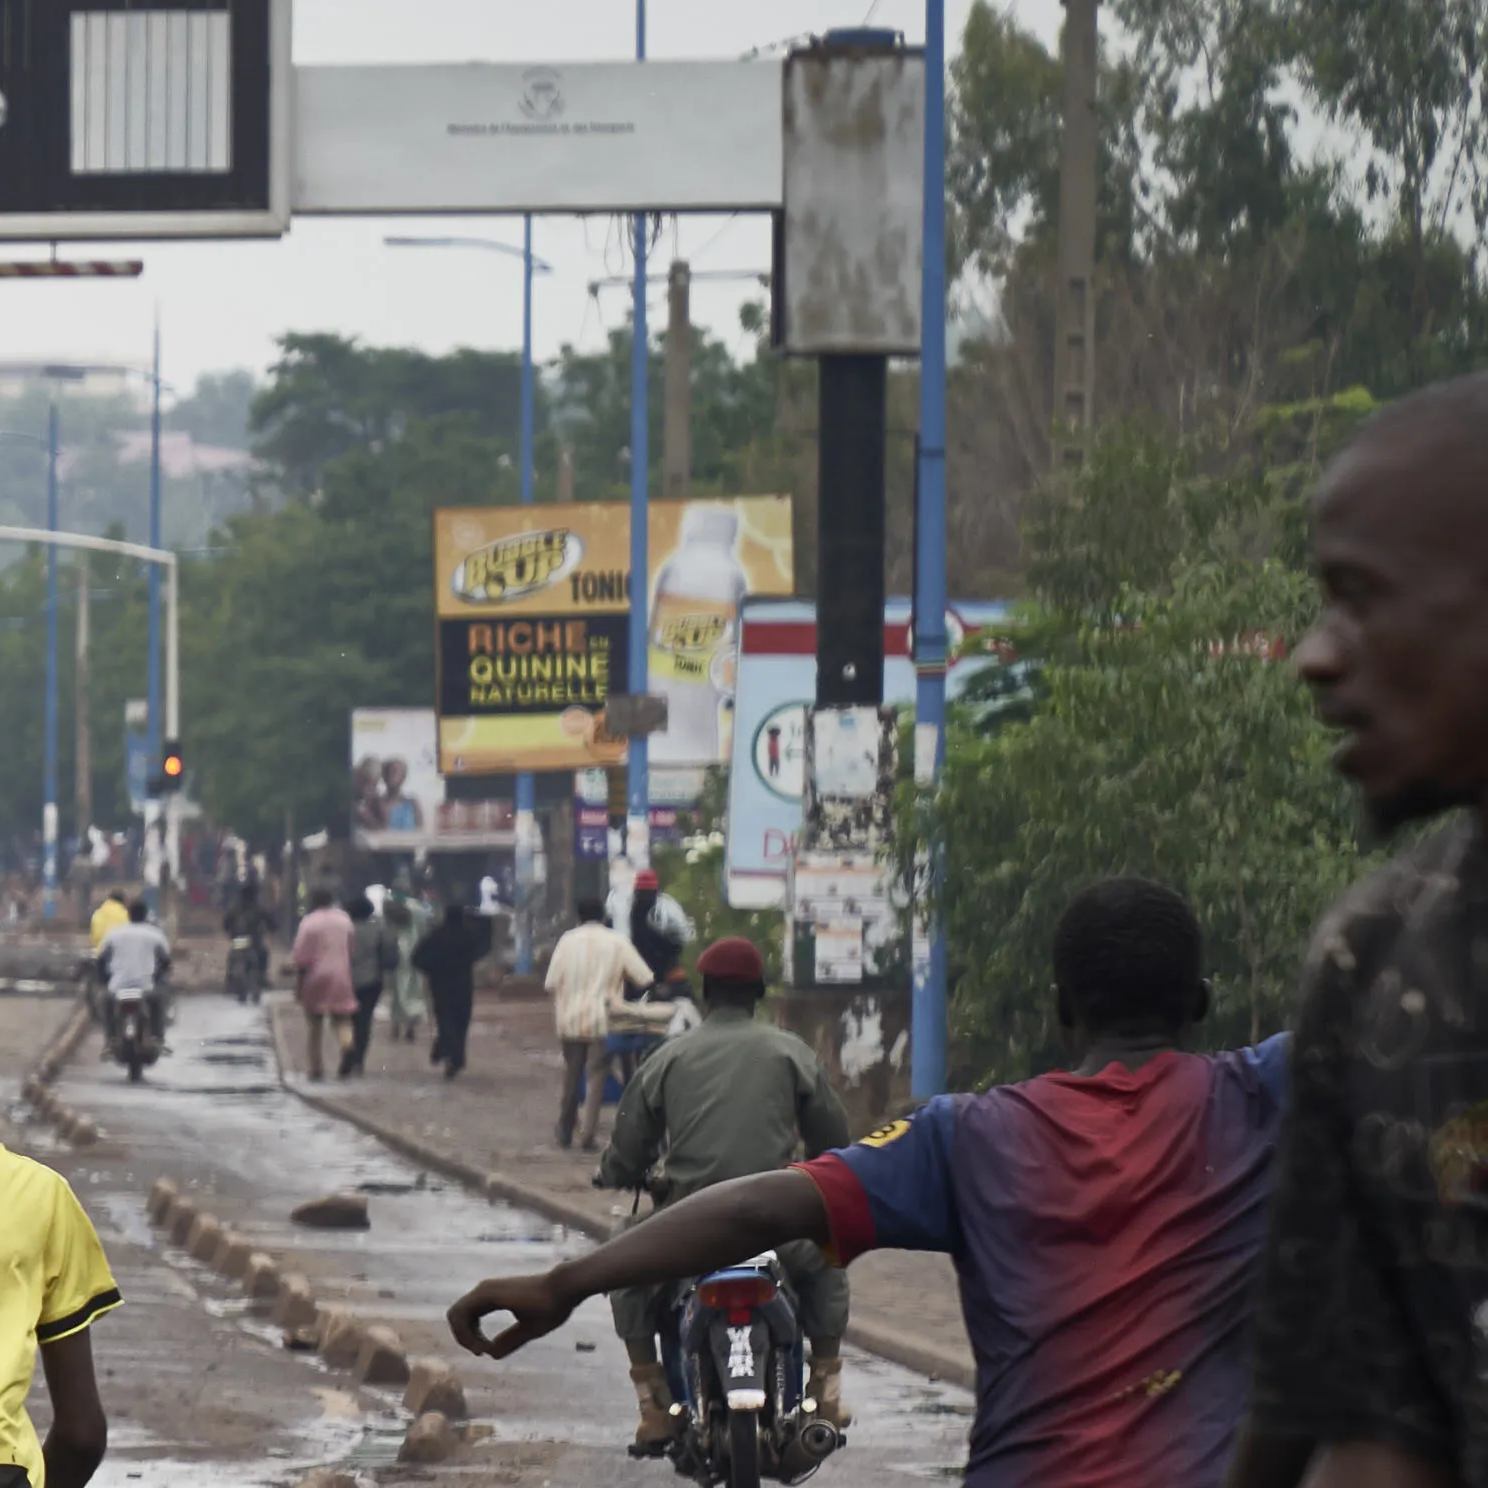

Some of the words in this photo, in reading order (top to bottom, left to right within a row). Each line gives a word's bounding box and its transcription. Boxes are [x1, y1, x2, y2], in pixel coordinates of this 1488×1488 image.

[469, 621, 587, 654] RICHE
[470, 653, 610, 685] QUININE
[470, 684, 609, 706] NATURELLE
